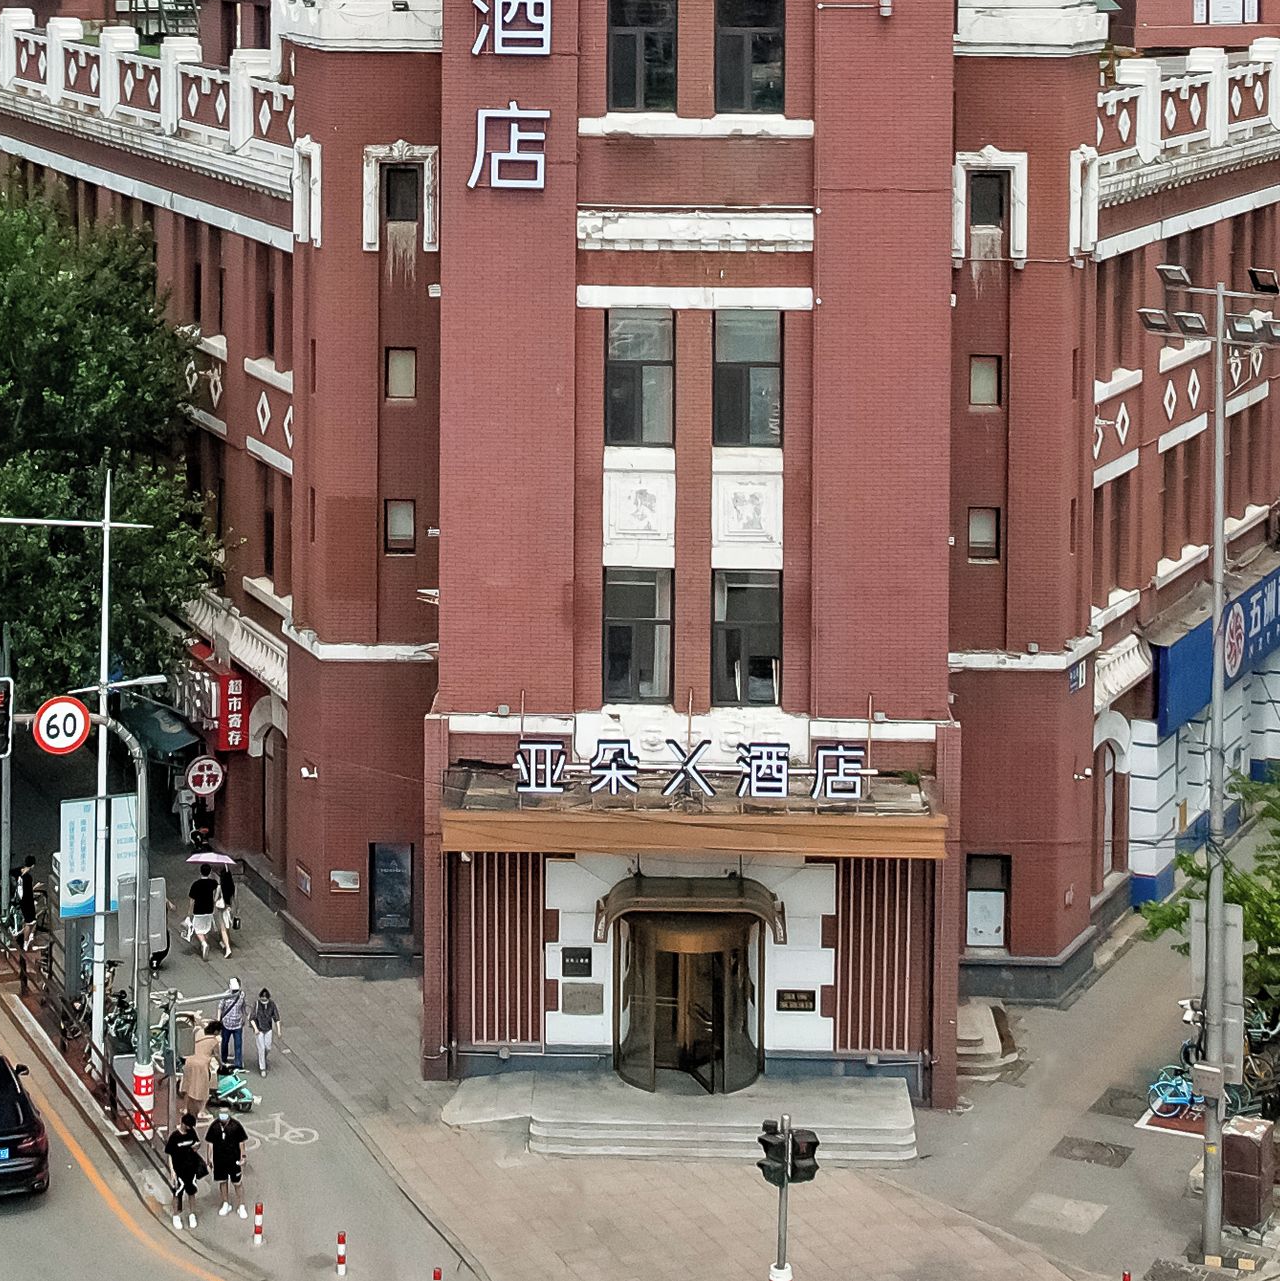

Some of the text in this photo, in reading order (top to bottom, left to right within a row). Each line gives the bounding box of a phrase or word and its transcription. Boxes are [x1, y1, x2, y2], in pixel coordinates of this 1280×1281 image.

[45, 712, 77, 739] 60
[228, 679, 243, 746] 超市寄存
[516, 738, 866, 801] 亚朵X酒店
